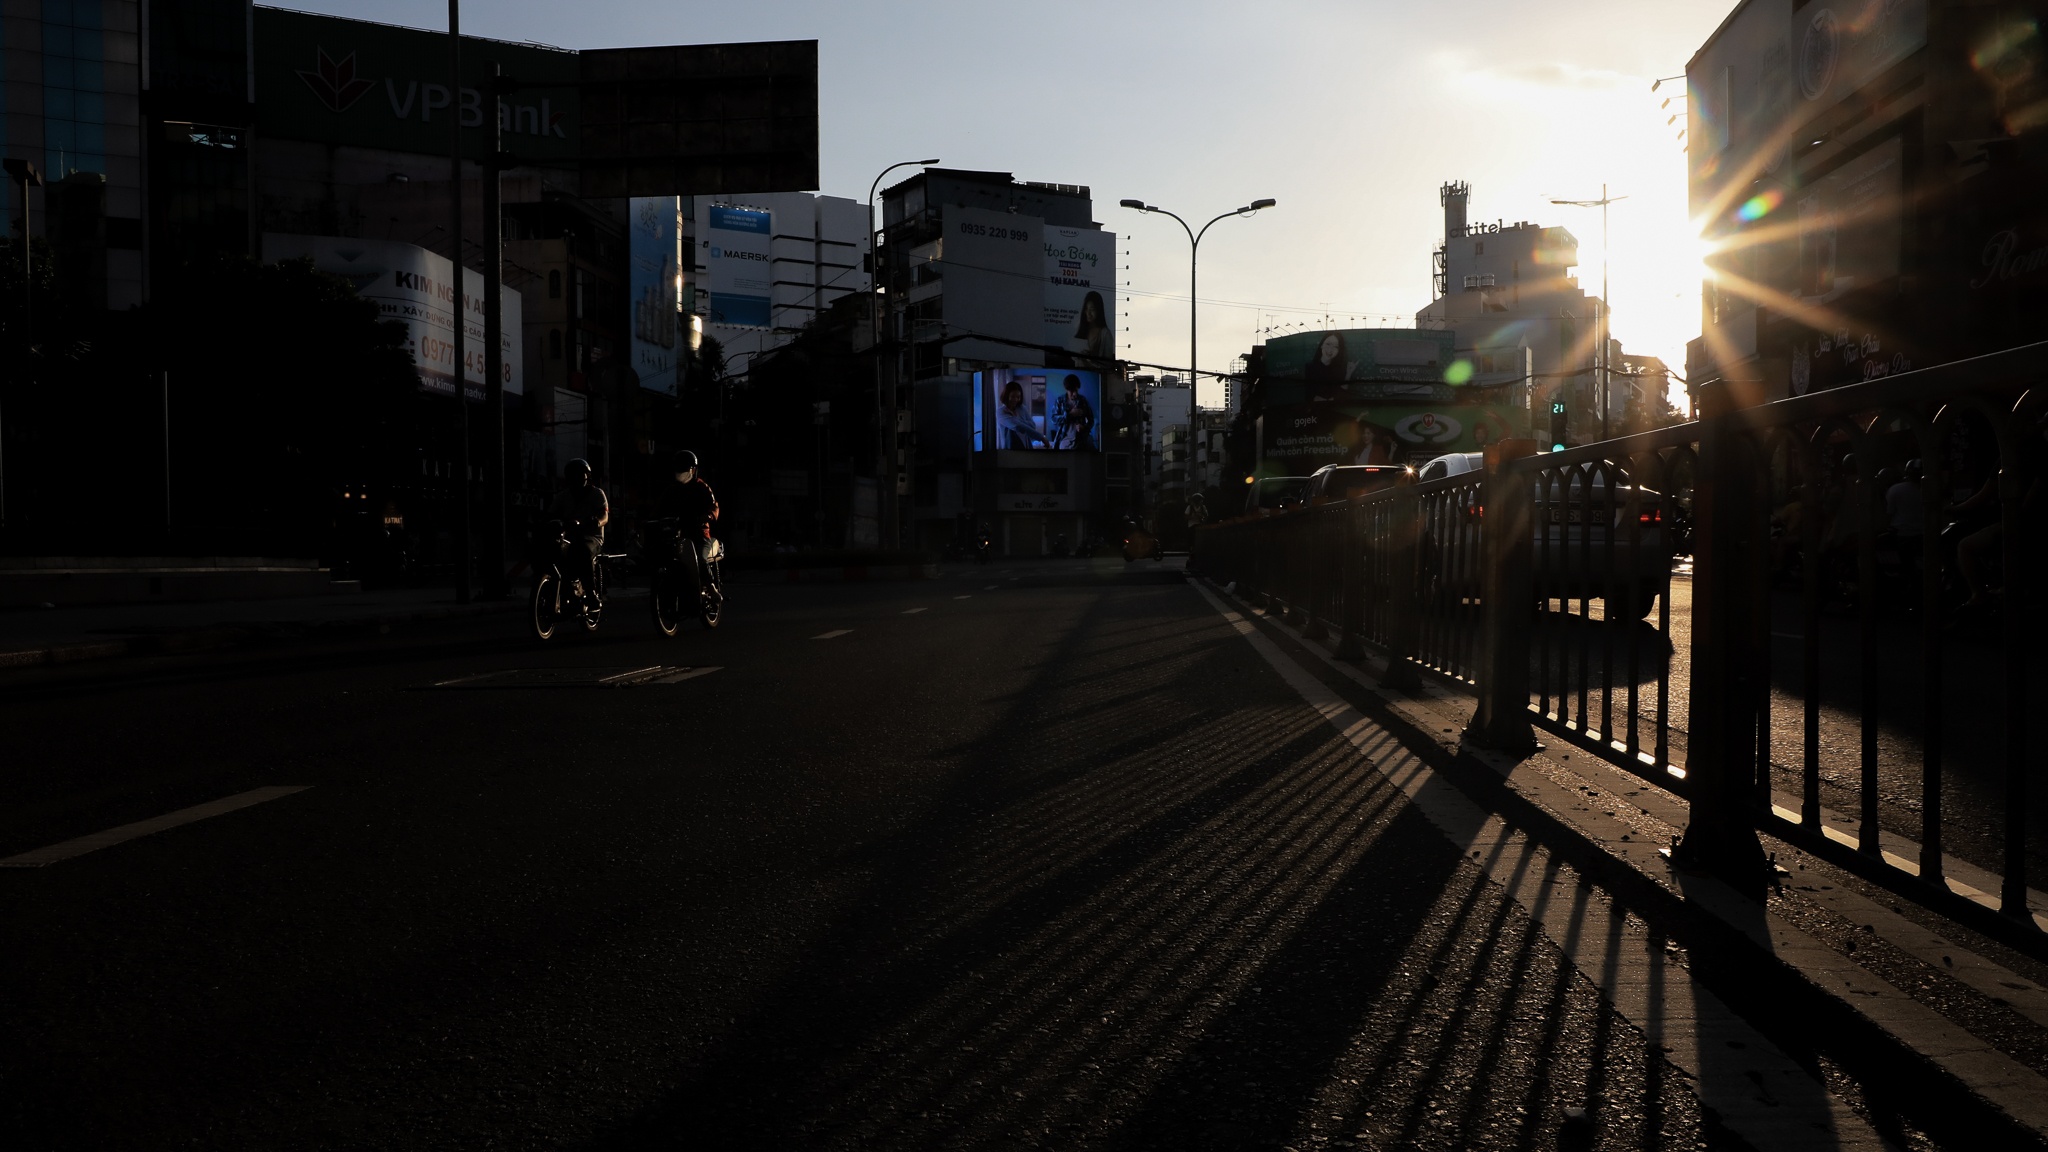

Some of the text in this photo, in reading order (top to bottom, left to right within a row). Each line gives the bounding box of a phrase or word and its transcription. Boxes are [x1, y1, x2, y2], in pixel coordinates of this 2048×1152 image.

[385, 78, 566, 140] VPBank
[961, 223, 1029, 241] 0935 220 999
[724, 250, 769, 262] MAERSK
[1044, 243, 1067, 260] Học
[1063, 269, 1078, 277] 2021
[1051, 277, 1090, 288] TẠI KAPLAN
[395, 271, 433, 296] KIM
[438, 279, 470, 311] NGN
[403, 305, 423, 317] XÂY
[469, 327, 482, 337] CÁO
[422, 336, 455, 366] 0977
[1553, 403, 1564, 414] 21
[1294, 416, 1318, 428] gojek
[1303, 444, 1349, 456] Freeship
